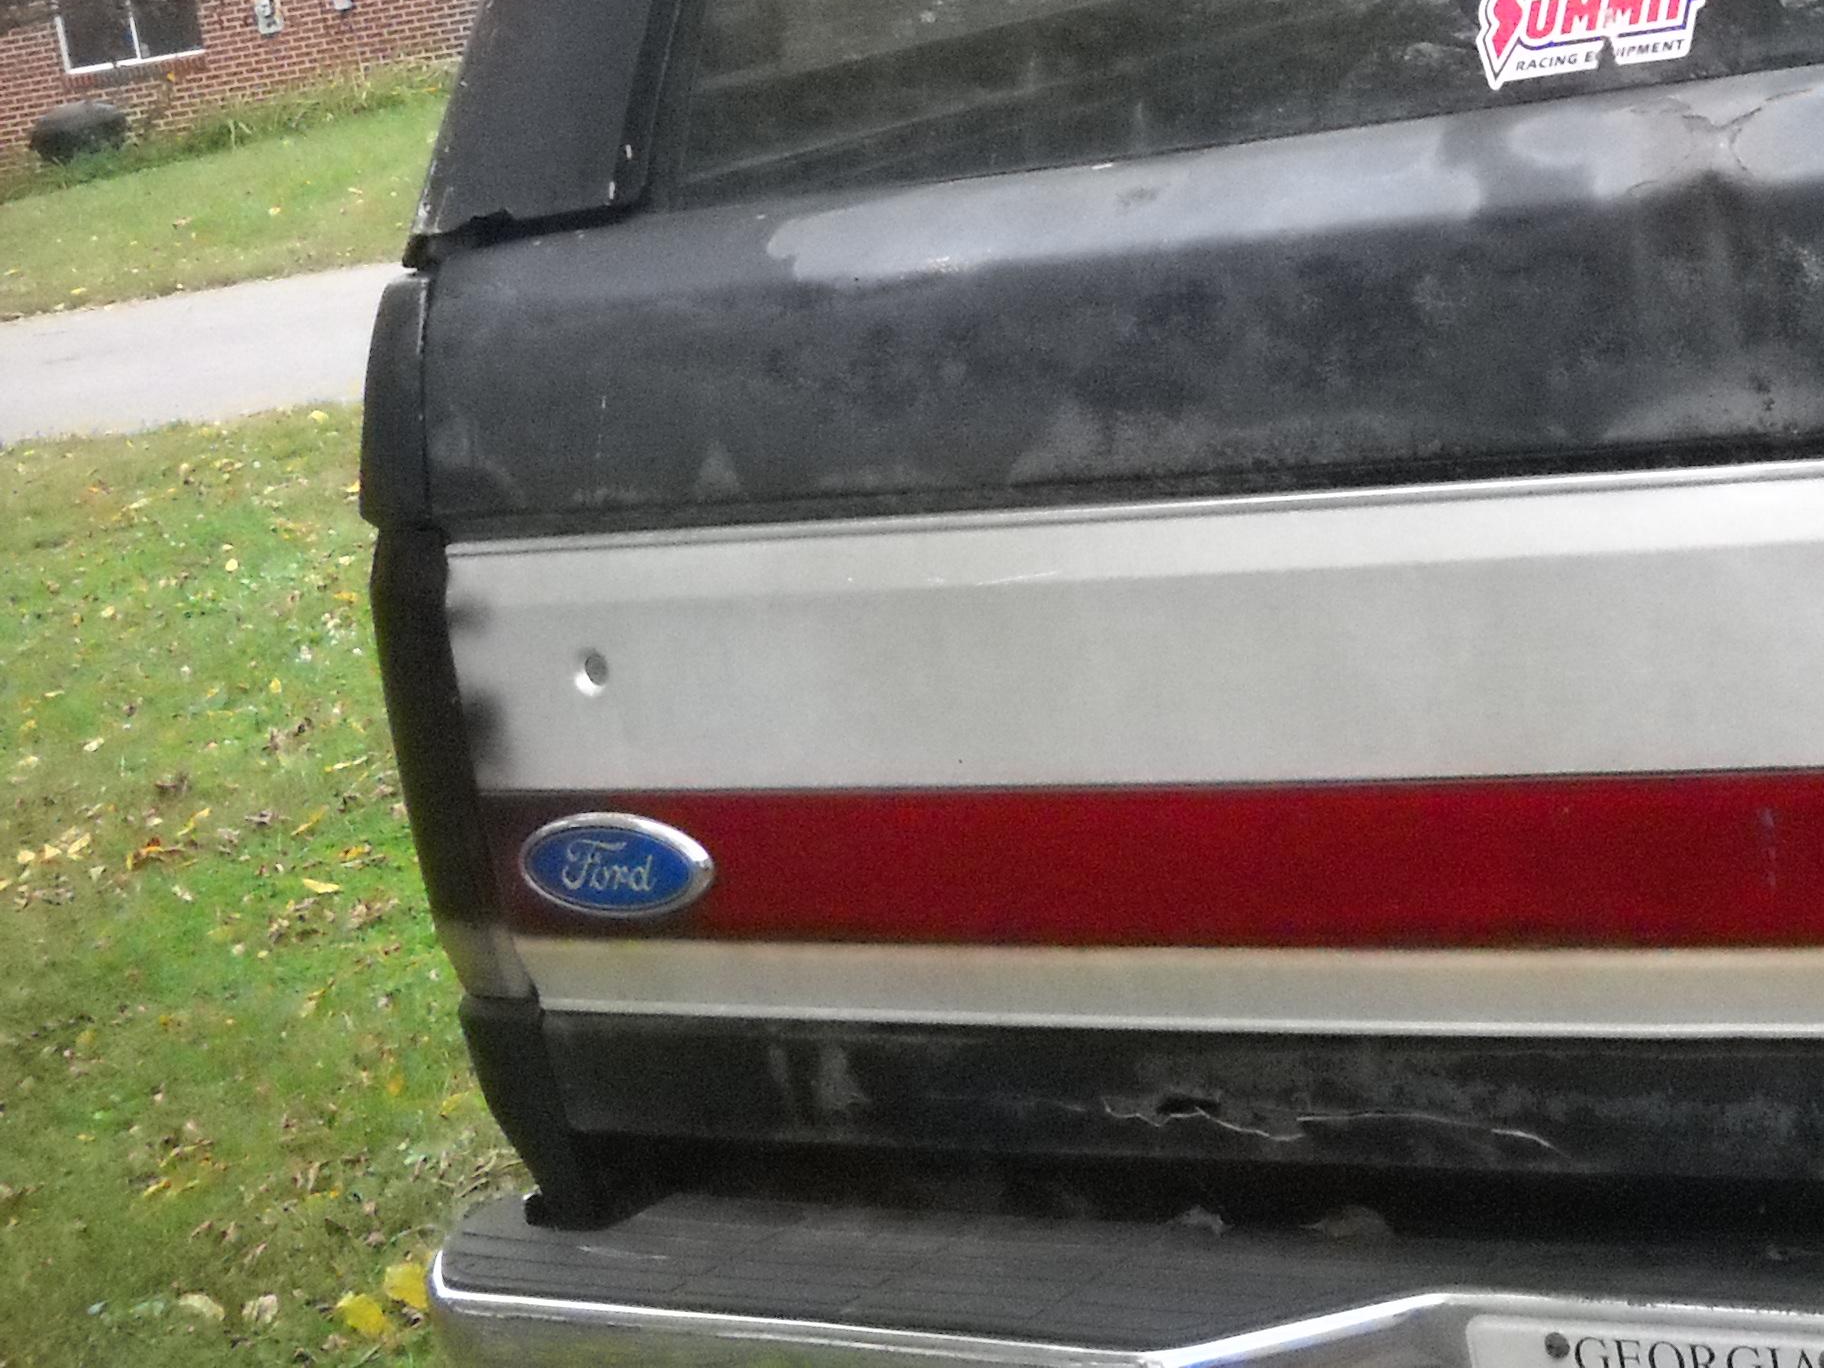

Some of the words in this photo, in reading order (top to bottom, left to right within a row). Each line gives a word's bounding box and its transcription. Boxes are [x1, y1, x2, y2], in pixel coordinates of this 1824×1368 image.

[1515, 54, 1578, 71] RACING
[1584, 38, 1685, 63] EIPMENT
[561, 838, 656, 890] Ford
